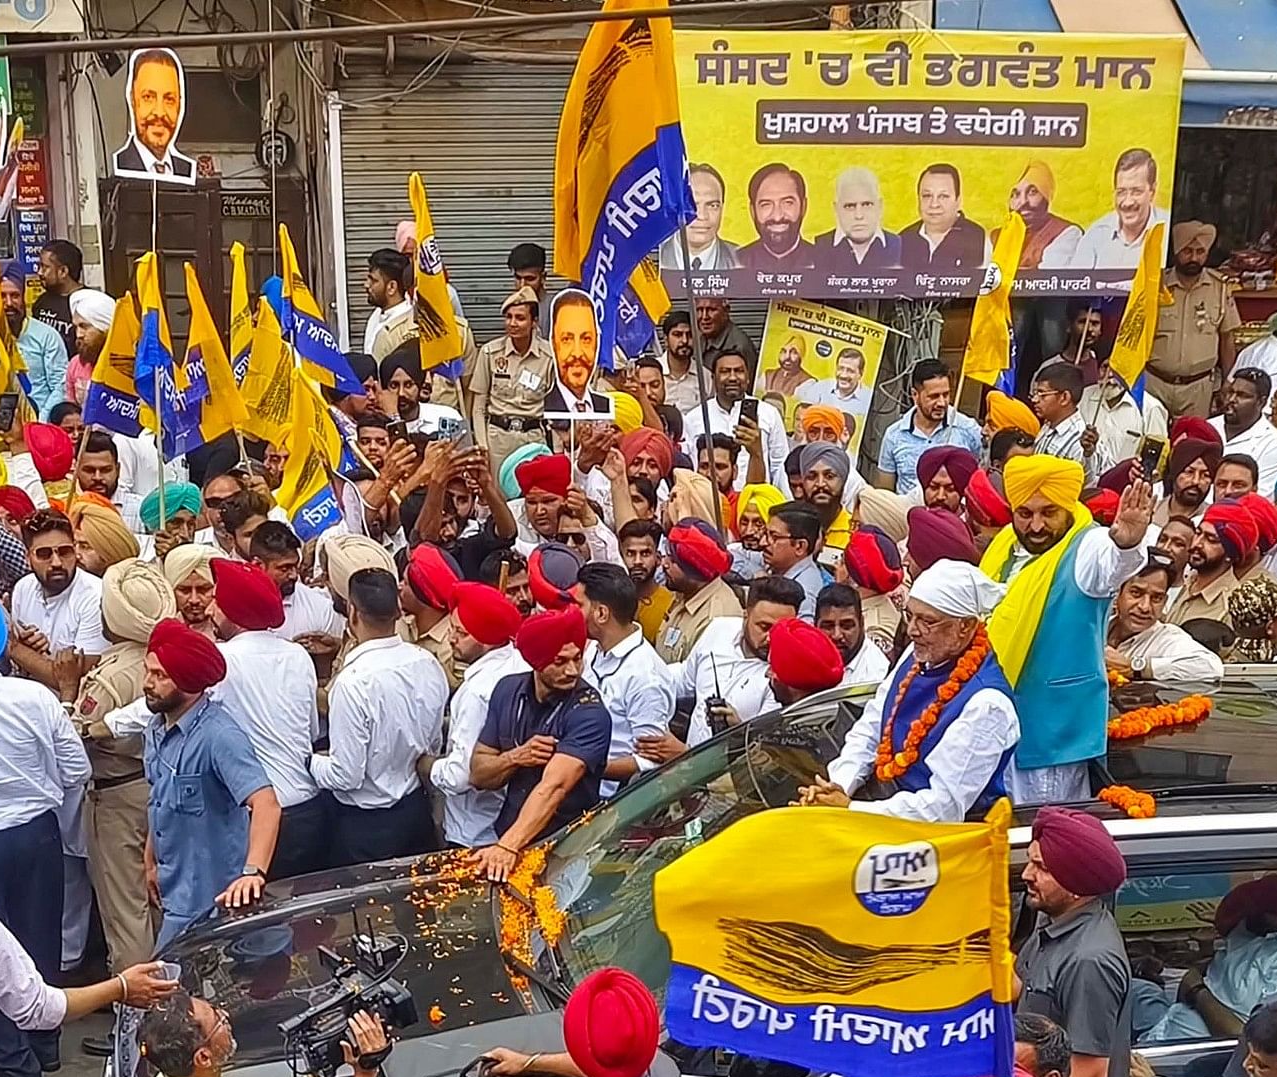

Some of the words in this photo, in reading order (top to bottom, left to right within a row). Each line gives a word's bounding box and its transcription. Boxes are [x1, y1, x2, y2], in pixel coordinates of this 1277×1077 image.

[695, 41, 791, 87] ਸੰਸਦ
[805, 50, 851, 87] 'ਚ
[865, 41, 910, 88] ਵੀ
[924, 43, 1063, 88] ਭਗਵੰਤ
[1075, 56, 1156, 90] ਮਾਨ
[763, 110, 851, 142] ਖੁਸ਼ਹਾਲ
[856, 105, 923, 136] ਪੰਜਾਬ
[929, 108, 947, 136] ਤੇ
[954, 106, 1026, 138] ਵਧੇਗੀ
[1032, 113, 1081, 138] ਸ਼ਾਨ
[1025, 278, 1058, 290] ਆਦਮੀ
[1060, 276, 1092, 290] ਪਾਰਟੀ
